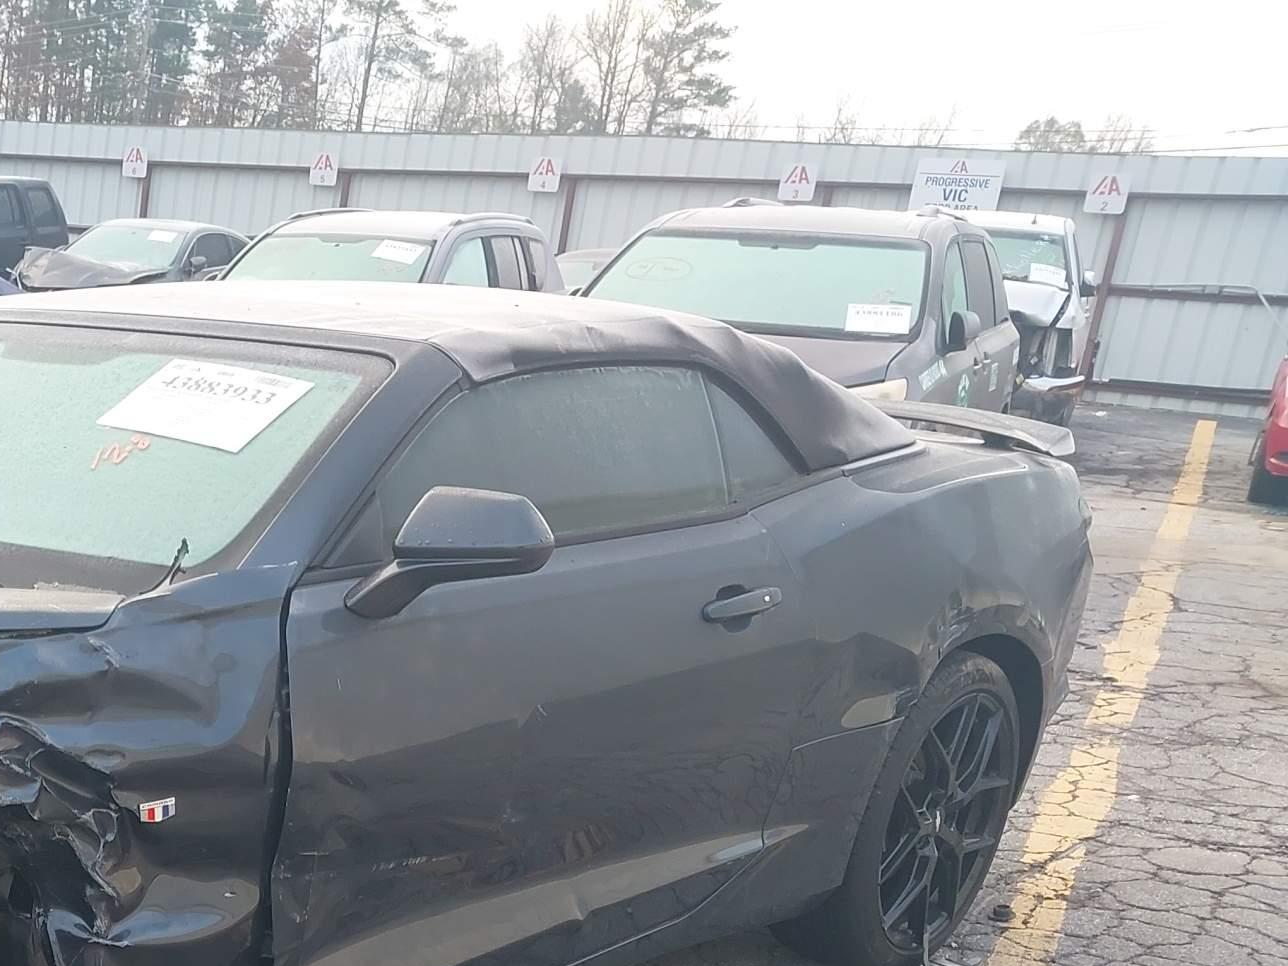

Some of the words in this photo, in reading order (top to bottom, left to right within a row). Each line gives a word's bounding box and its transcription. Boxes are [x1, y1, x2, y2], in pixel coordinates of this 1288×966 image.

[540, 181, 546, 190] 4
[925, 175, 991, 189] PROGRESSIVE
[792, 189, 800, 199] 3
[943, 188, 969, 202] VIC
[1101, 201, 1109, 211] 2
[161, 375, 279, 406] 43883933
